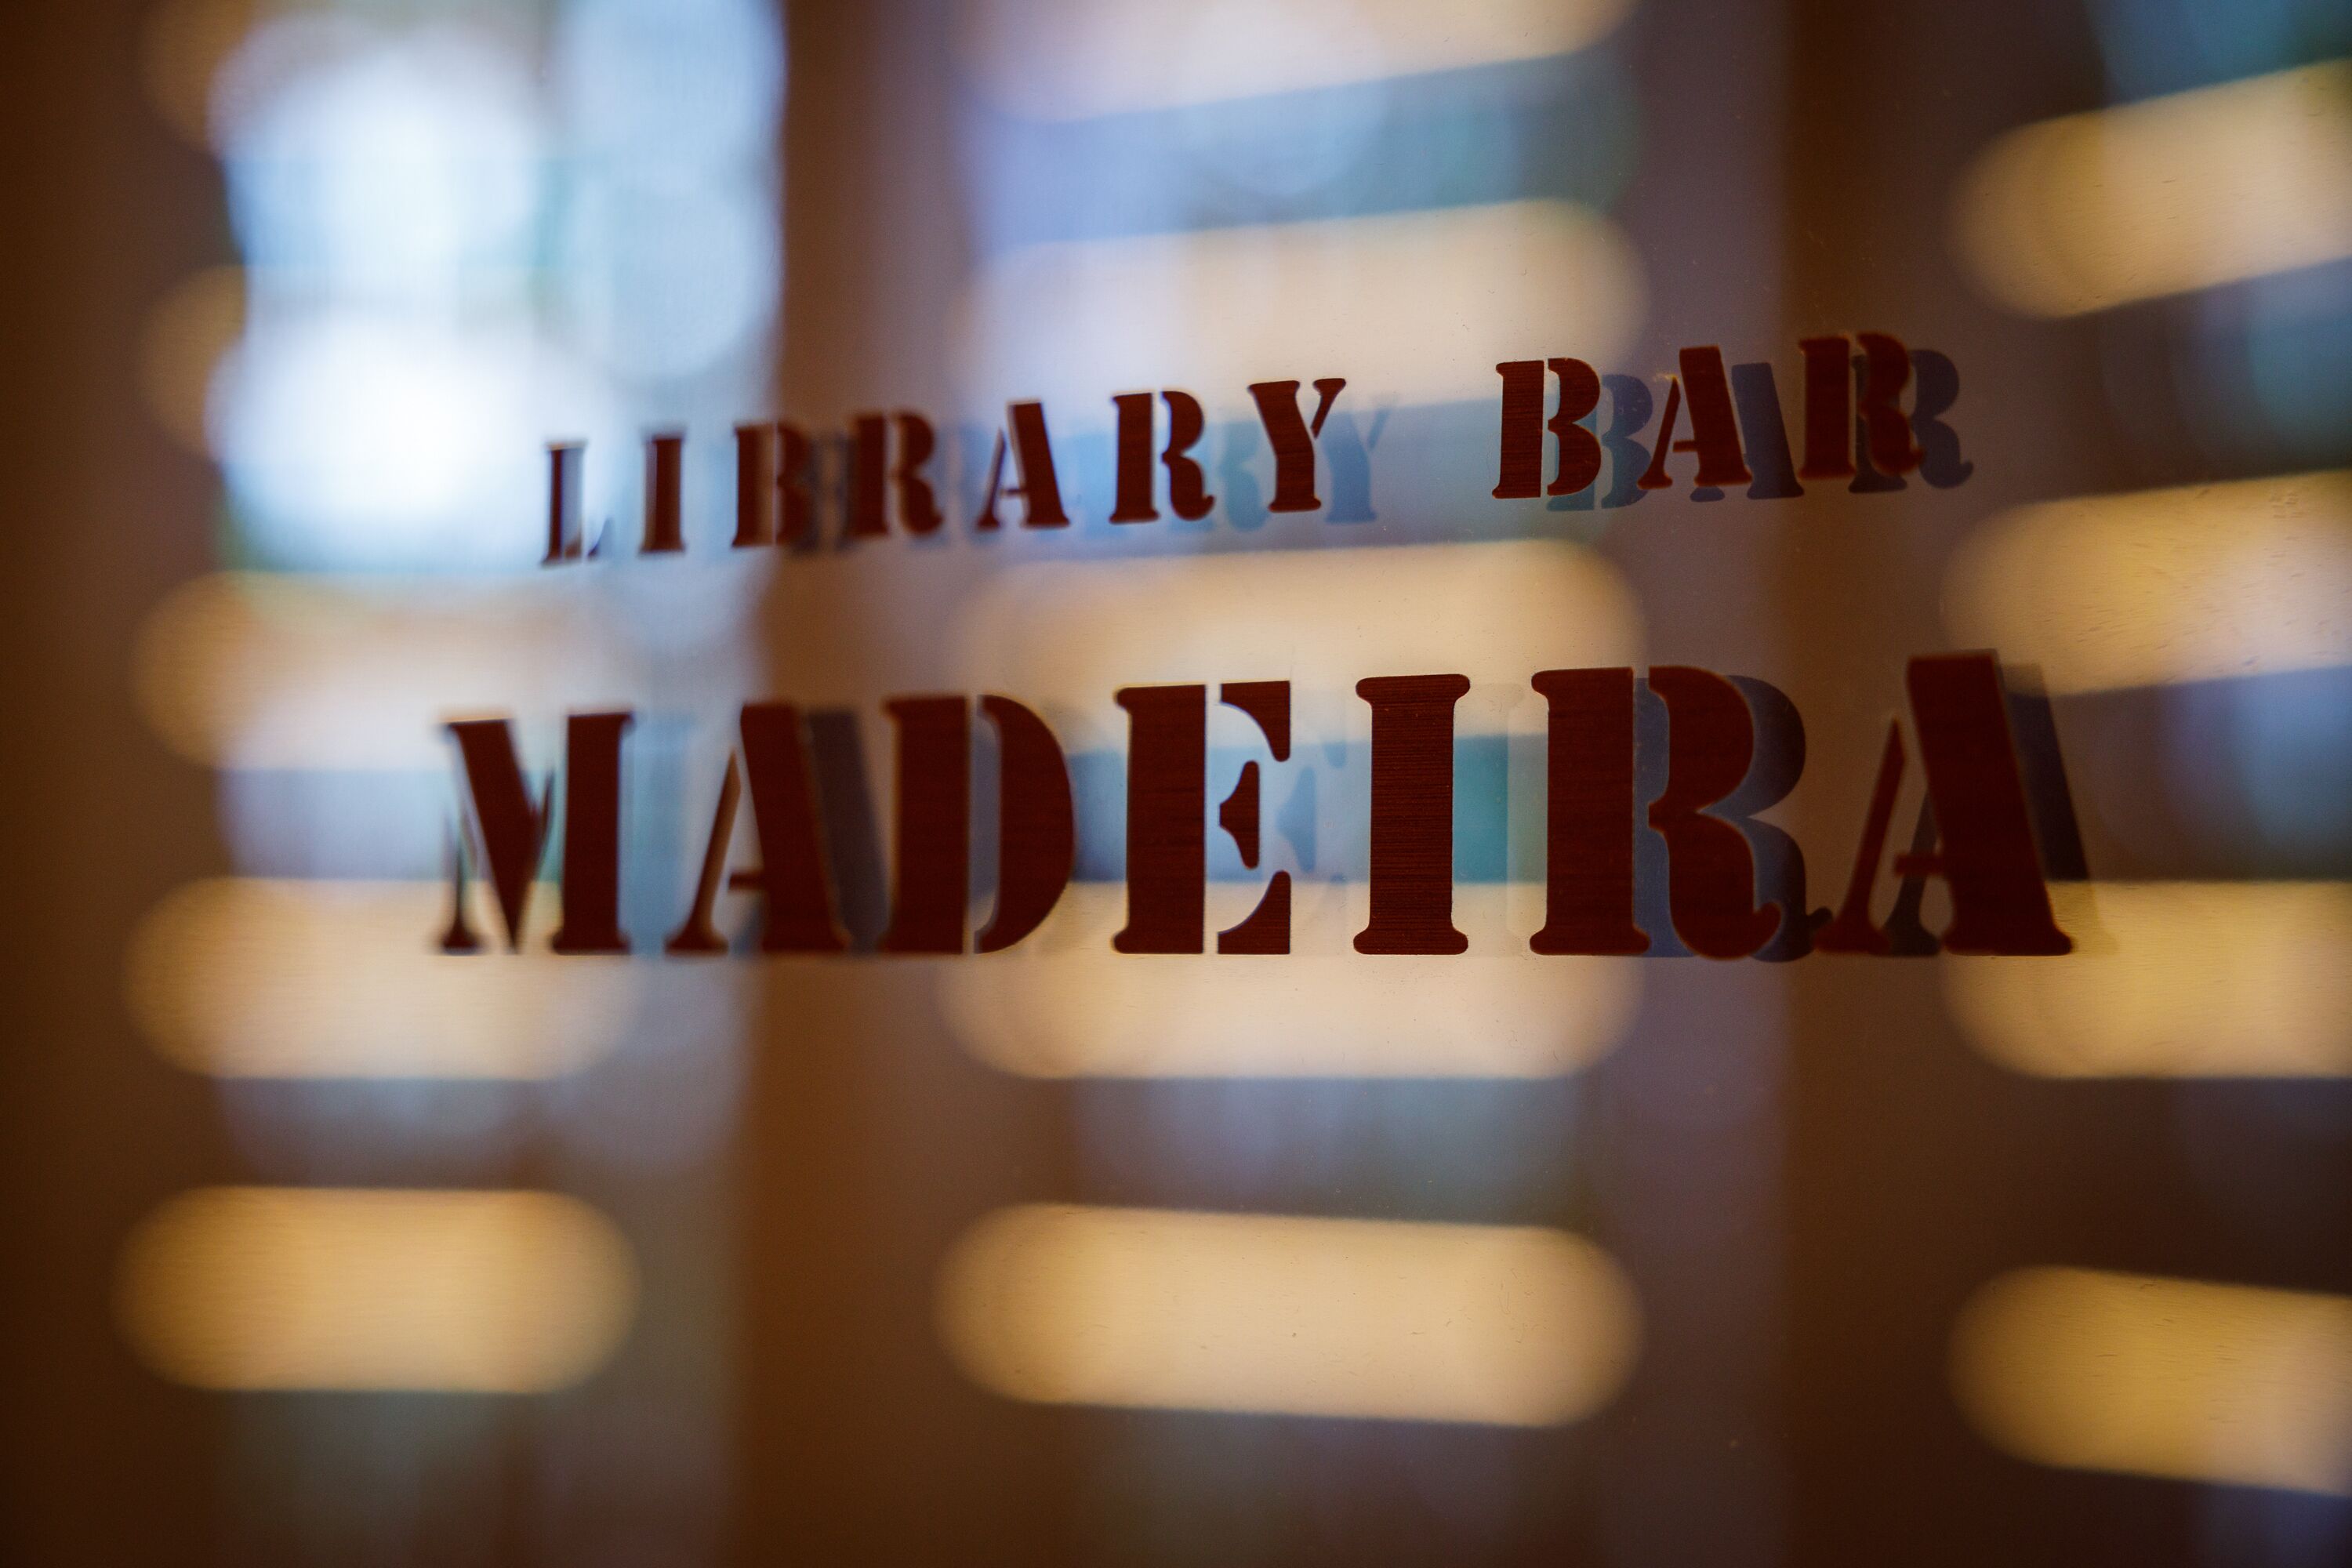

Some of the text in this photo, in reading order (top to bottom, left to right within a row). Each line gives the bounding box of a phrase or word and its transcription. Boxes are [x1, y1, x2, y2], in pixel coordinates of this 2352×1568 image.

[542, 333, 1924, 565] LIBRARY BAR
[439, 651, 2074, 959] MADEIRA
